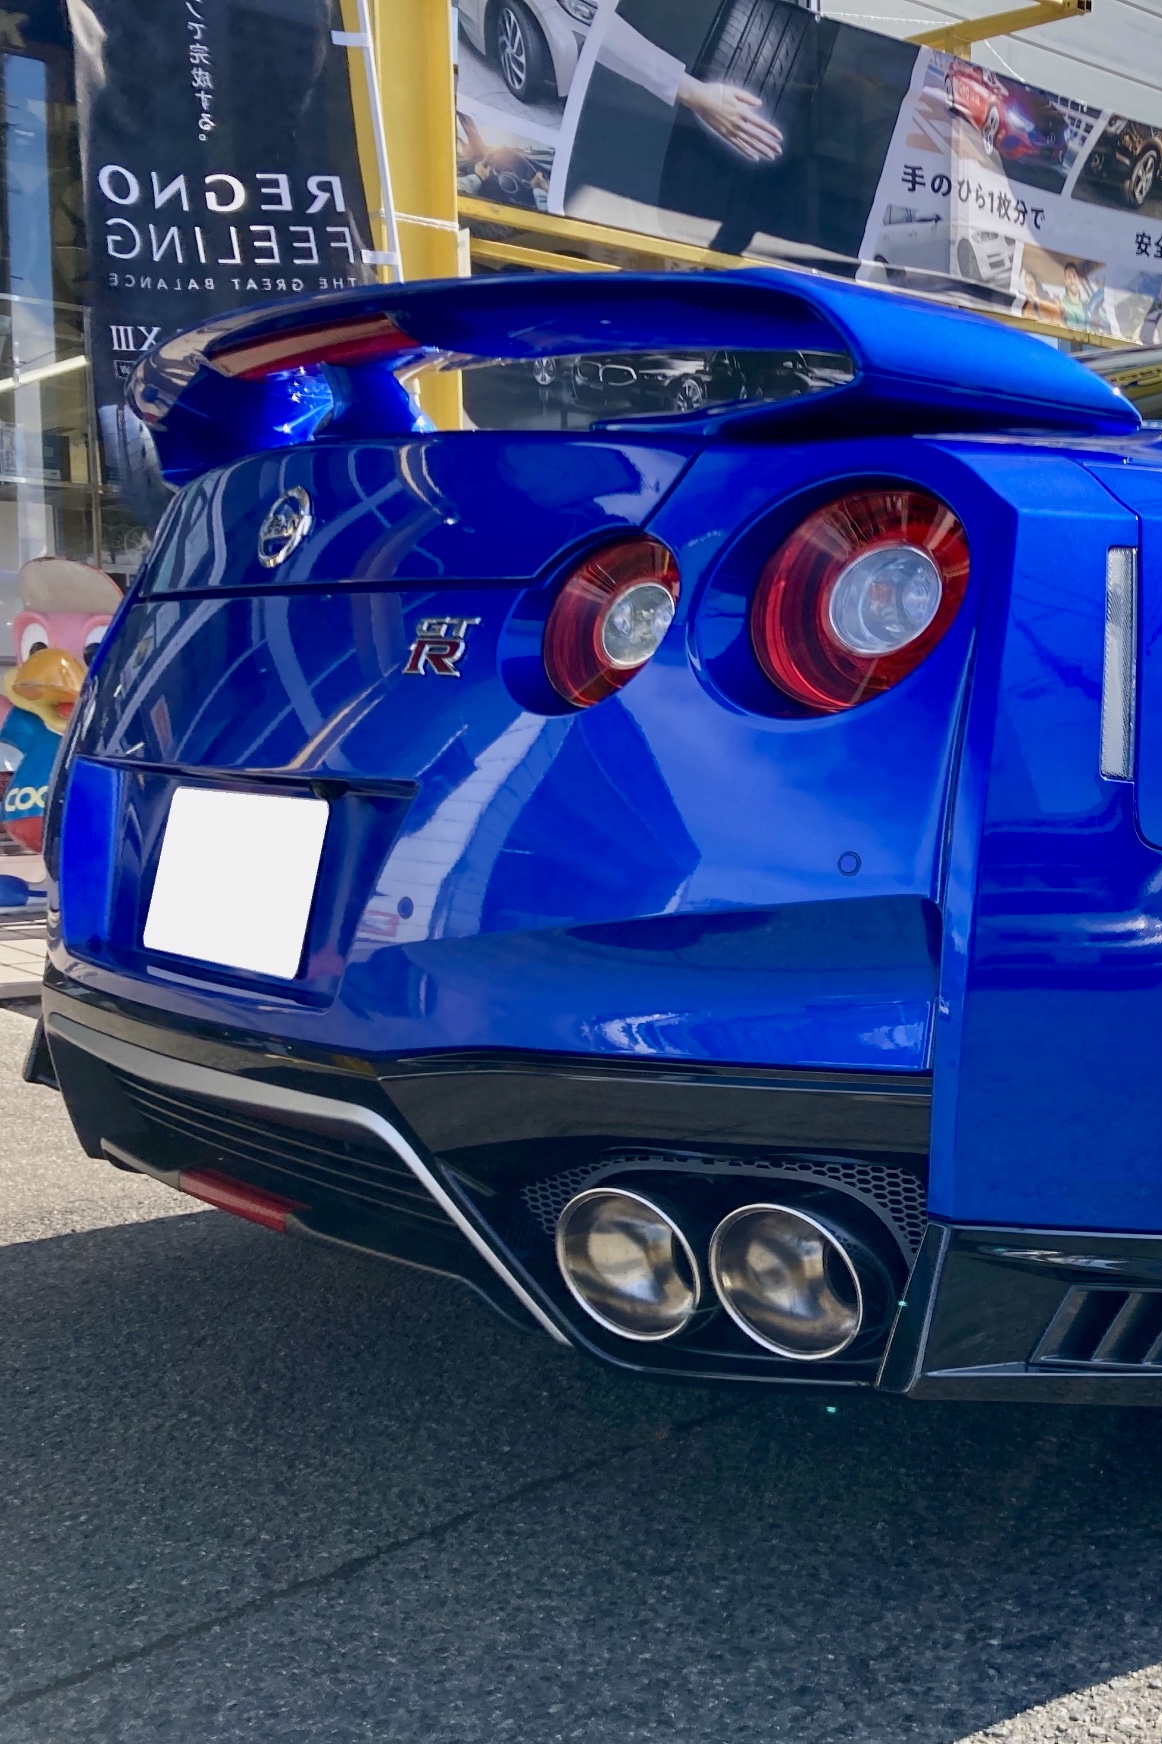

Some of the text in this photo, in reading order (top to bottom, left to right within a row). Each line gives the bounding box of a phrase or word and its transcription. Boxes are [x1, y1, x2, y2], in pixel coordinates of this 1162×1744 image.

[901, 164, 1046, 230] 手のひら1枚分で
[416, 617, 482, 638] GT
[402, 637, 466, 678] R
